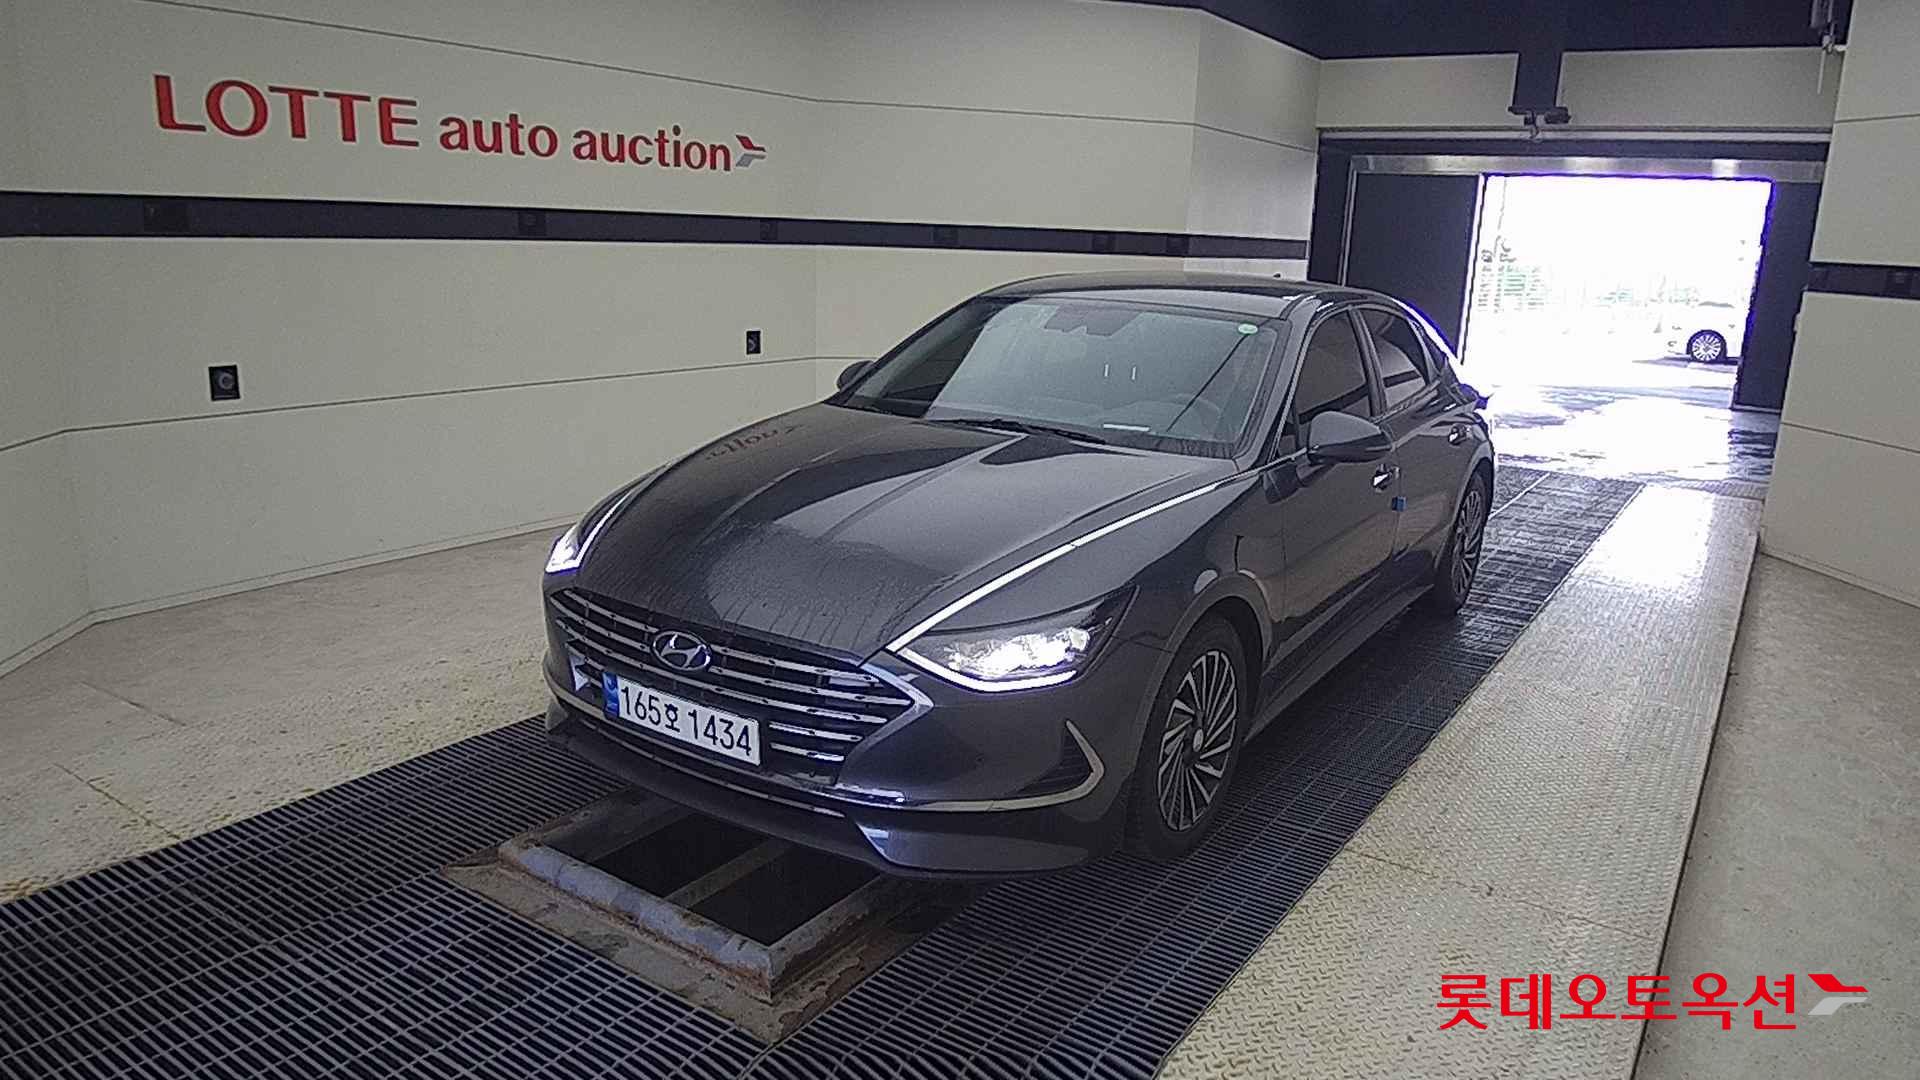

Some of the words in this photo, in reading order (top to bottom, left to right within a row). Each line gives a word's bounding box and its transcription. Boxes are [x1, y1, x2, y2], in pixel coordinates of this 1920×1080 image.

[152, 74, 419, 148] LOTTE
[439, 114, 558, 159] auto
[572, 125, 732, 172] auction
[621, 686, 680, 733] 165호
[687, 709, 753, 757] 1434
